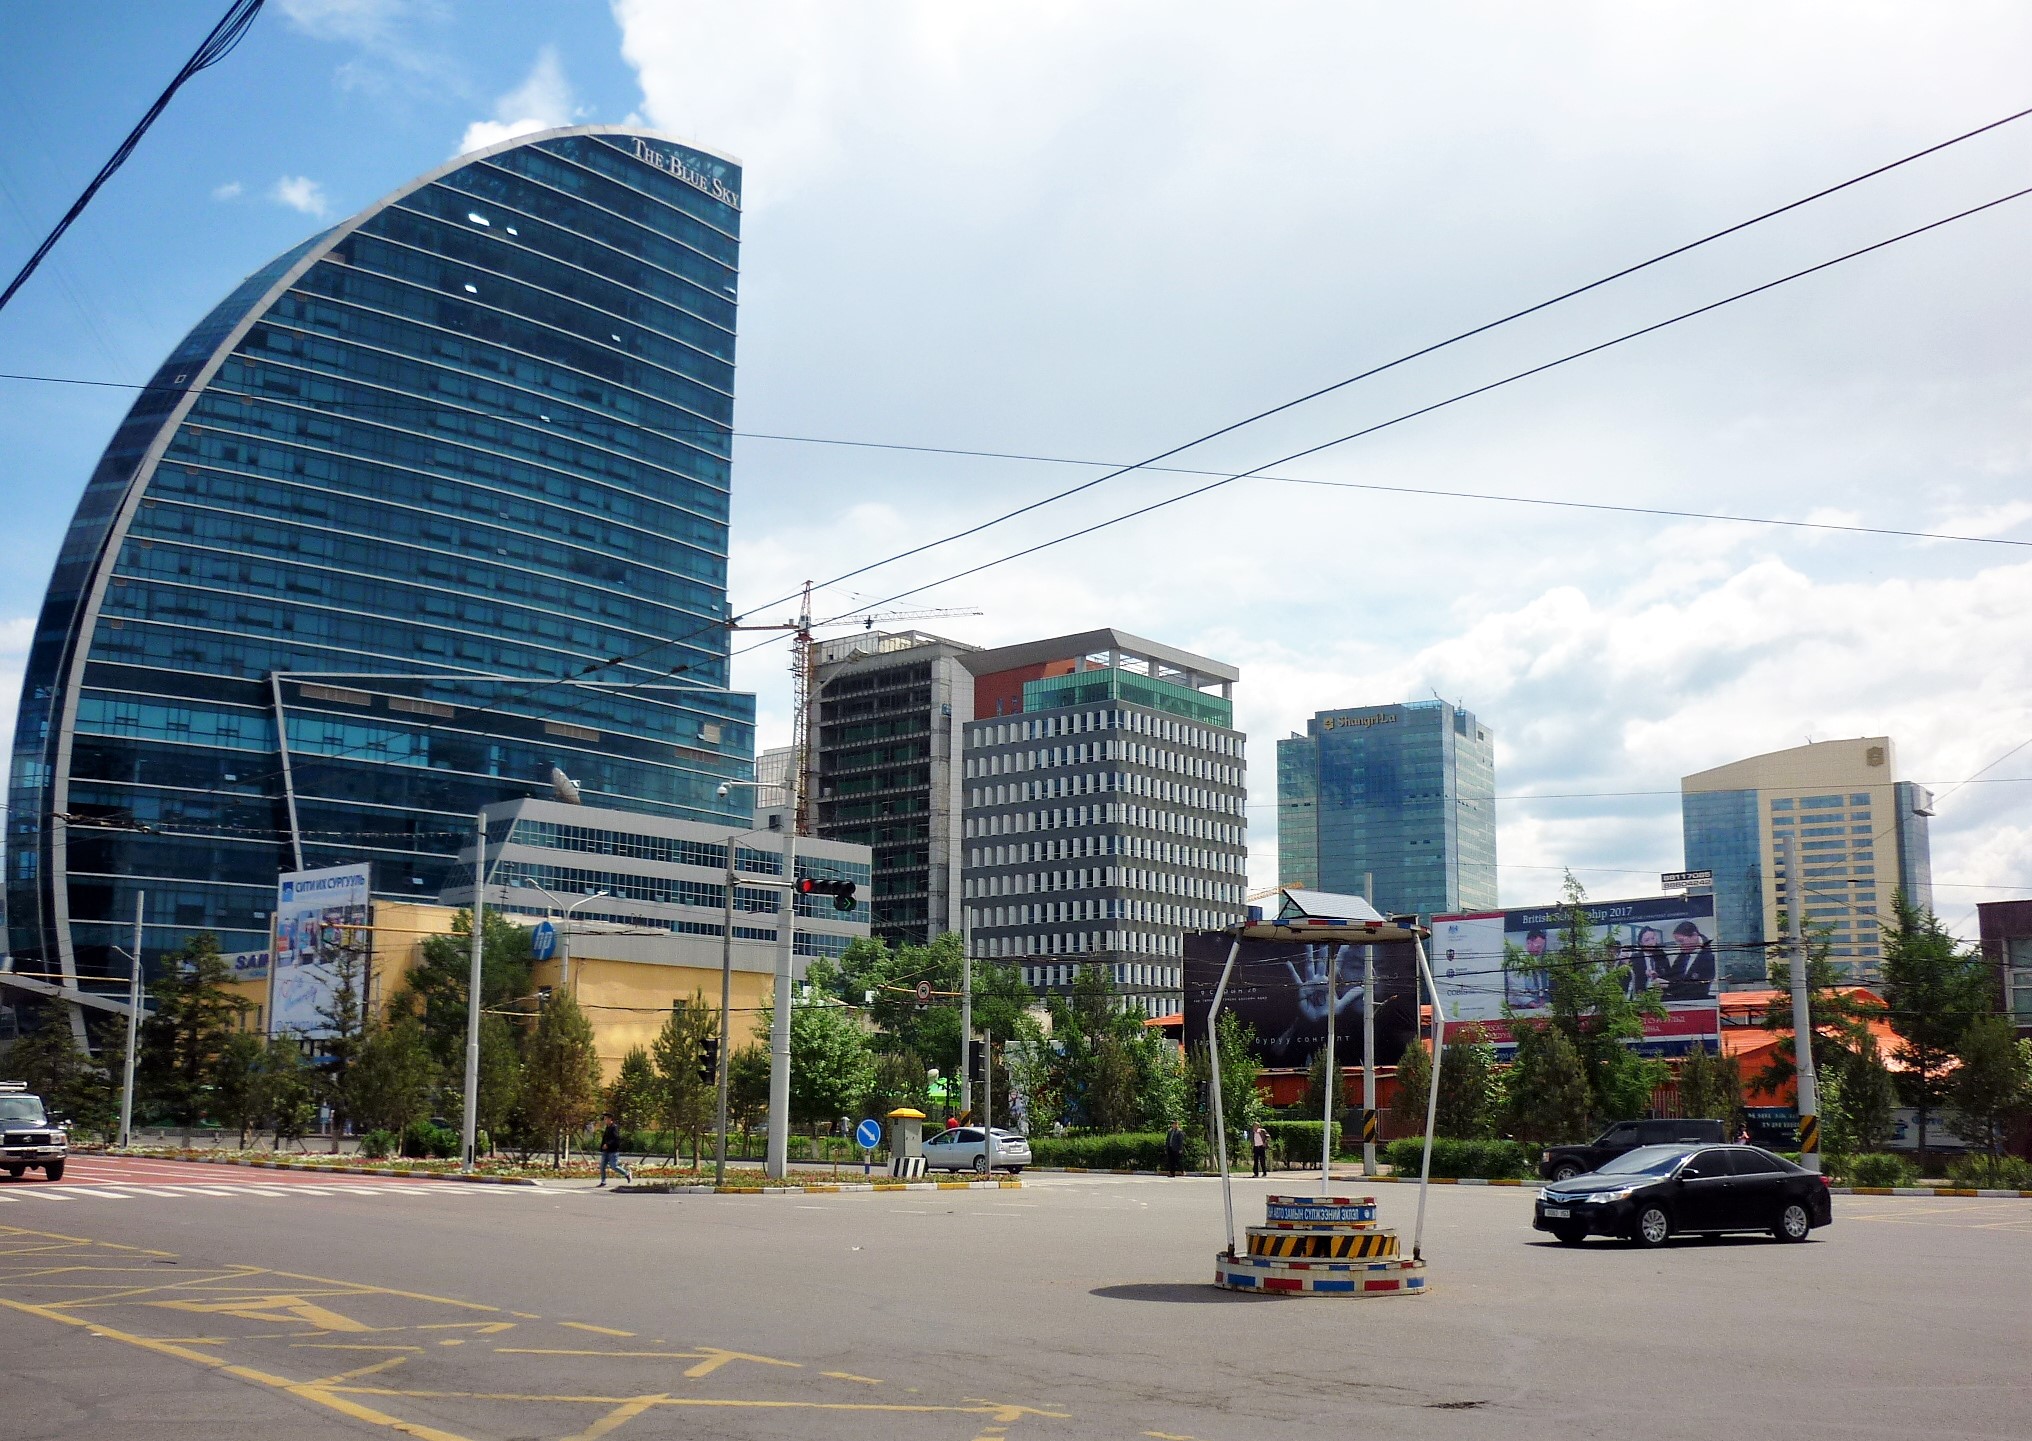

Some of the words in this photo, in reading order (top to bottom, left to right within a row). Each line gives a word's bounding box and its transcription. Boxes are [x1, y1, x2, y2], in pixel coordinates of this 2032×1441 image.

[631, 137, 664, 168] THE
[668, 155, 708, 191] BLUE
[712, 177, 740, 207] SKY
[295, 880, 315, 893] СИТИ
[316, 879, 327, 891] ИХ
[1609, 906, 1633, 918] 2017
[533, 923, 553, 960] hp
[1255, 1036, 1291, 1045] буруу
[1296, 1034, 1351, 1044] сонглт
